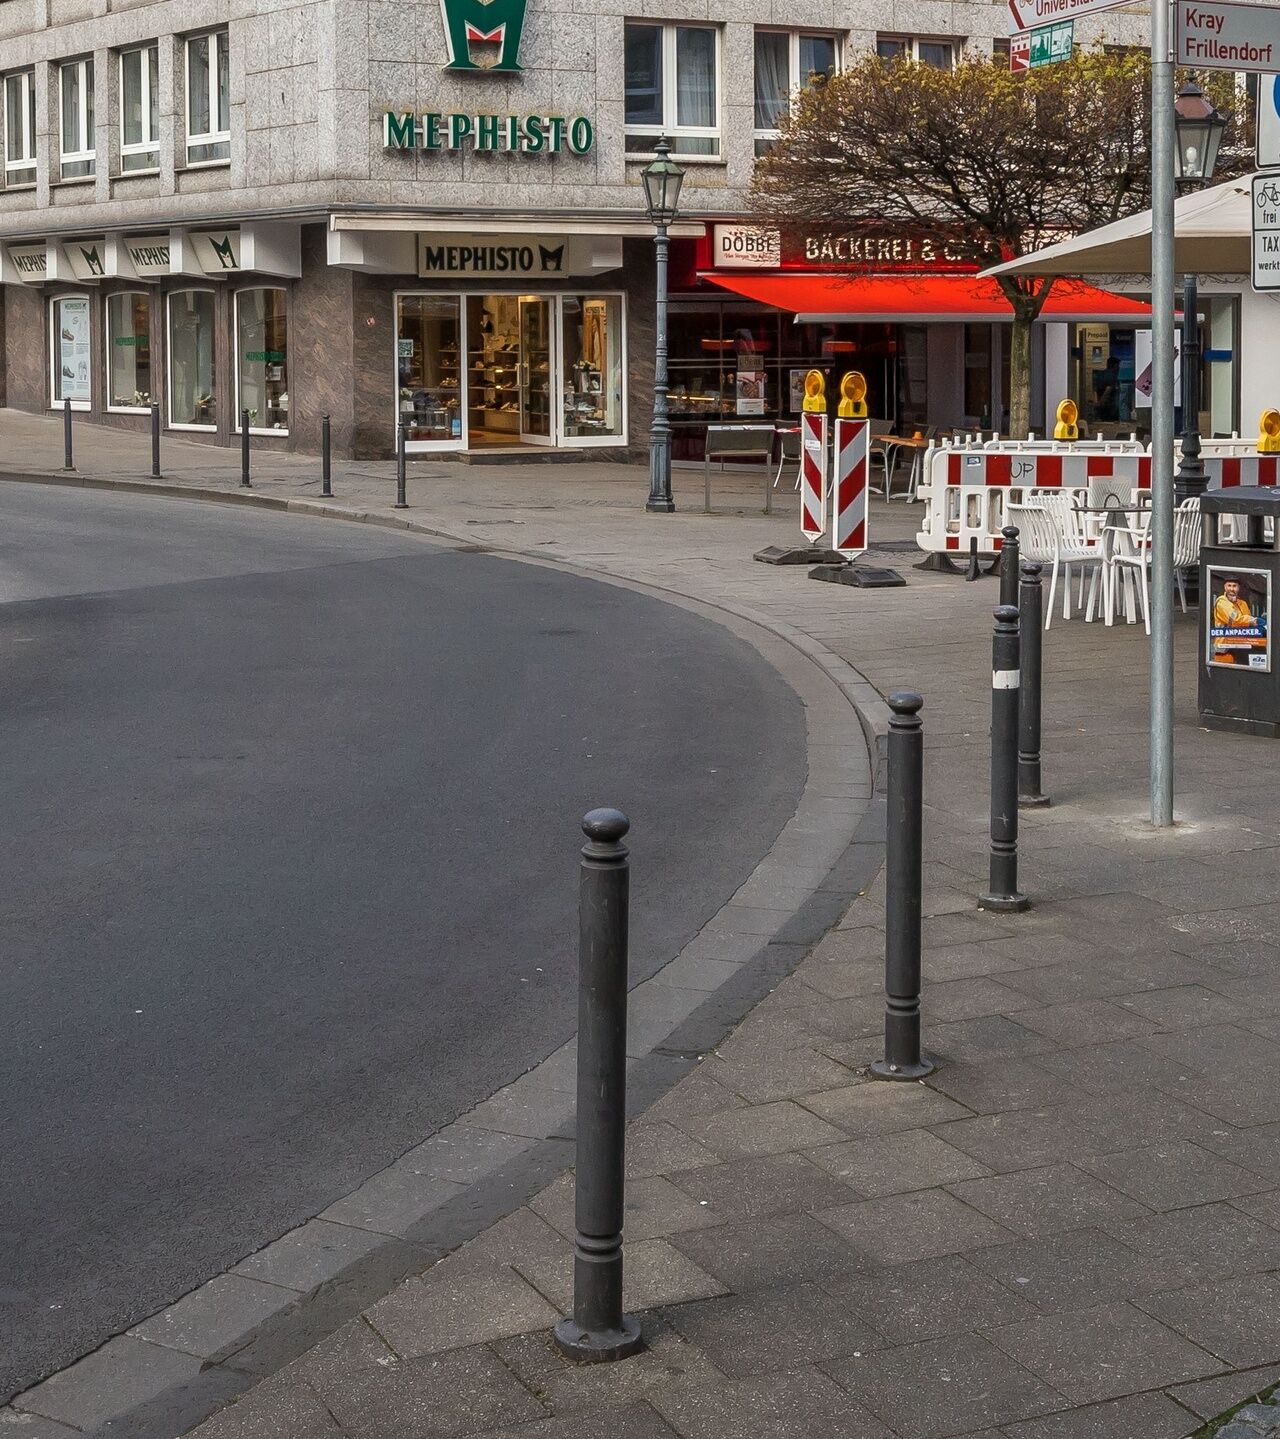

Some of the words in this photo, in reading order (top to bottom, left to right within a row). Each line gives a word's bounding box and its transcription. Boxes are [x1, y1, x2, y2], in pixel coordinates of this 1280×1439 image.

[1186, 8, 1225, 34] Kray
[1186, 38, 1272, 63] Frillendorf
[383, 111, 593, 155] MEPHISTO
[1263, 209, 1277, 224] frei
[14, 254, 48, 273] MEPHIS
[425, 246, 533, 271] MEPHISTO
[1224, 628, 1261, 636] ANPACKER.
